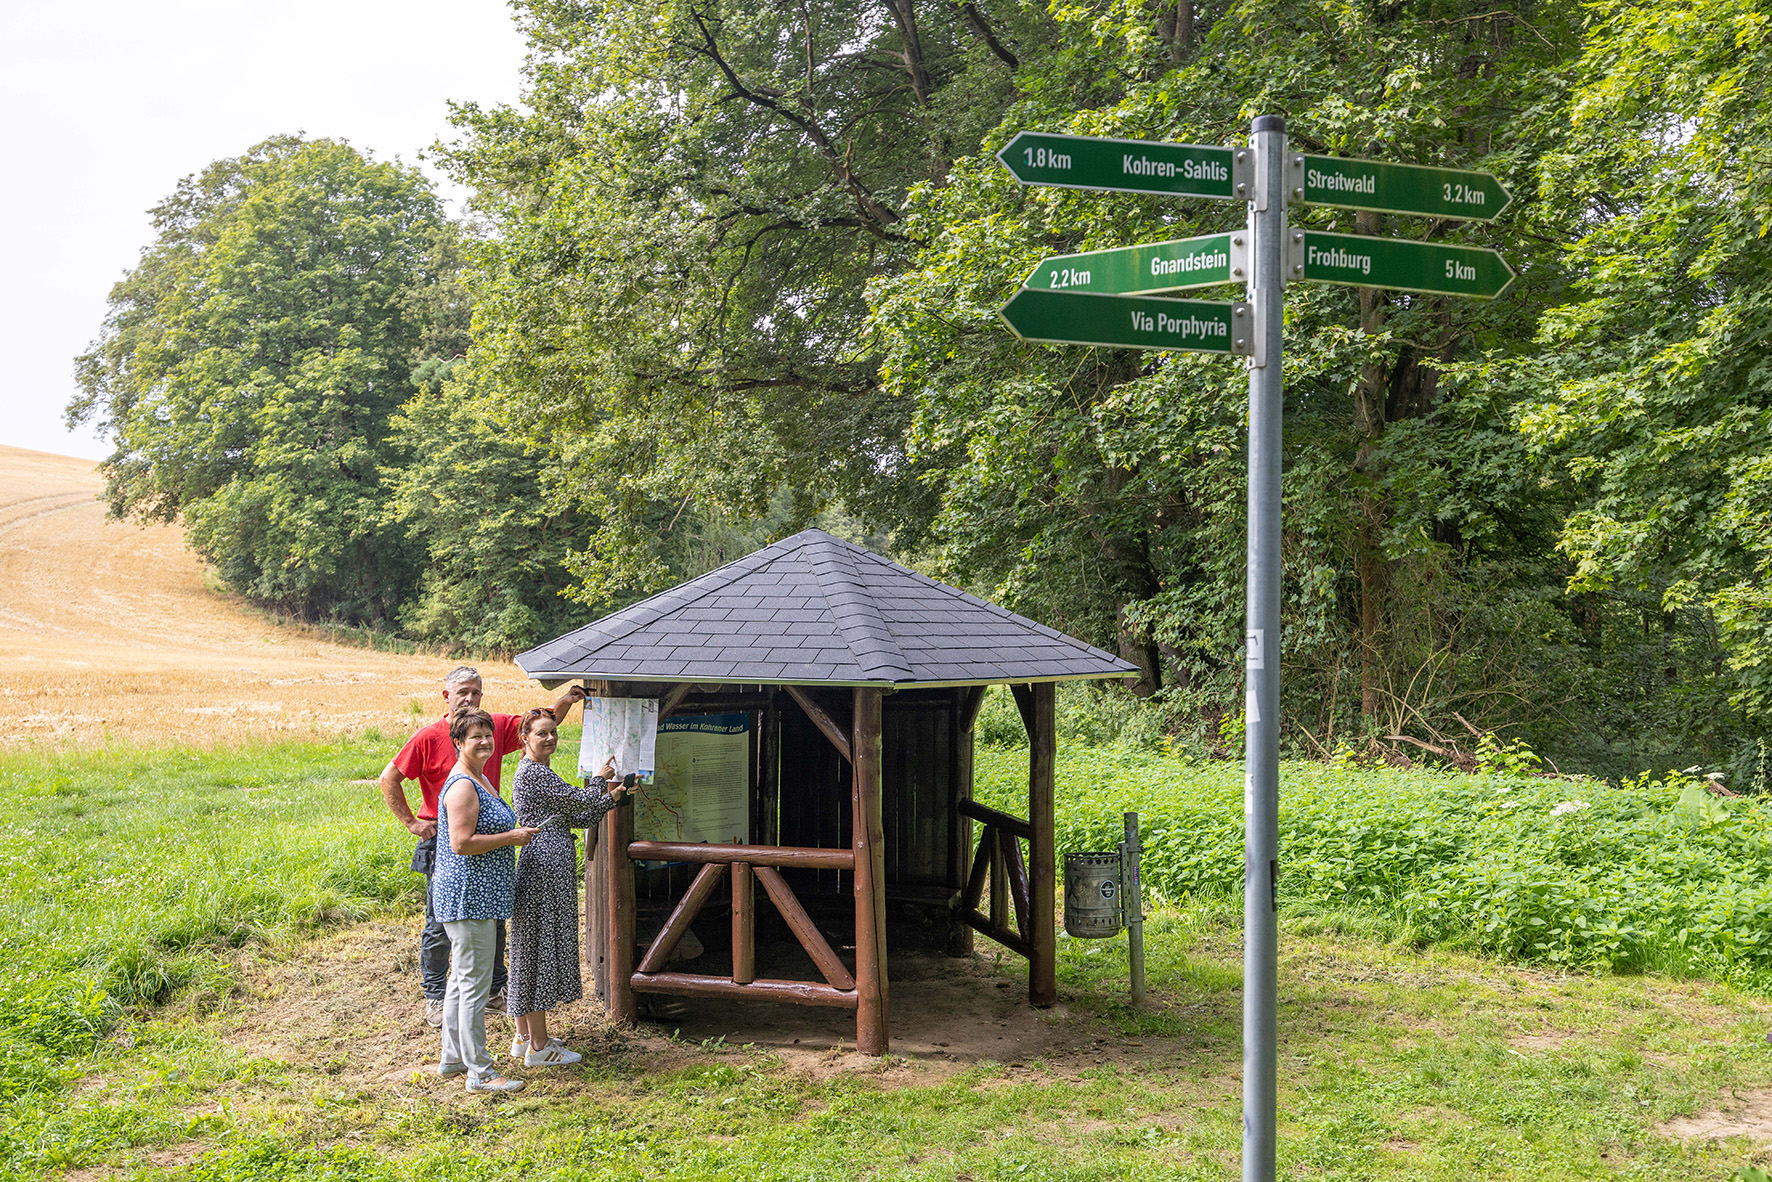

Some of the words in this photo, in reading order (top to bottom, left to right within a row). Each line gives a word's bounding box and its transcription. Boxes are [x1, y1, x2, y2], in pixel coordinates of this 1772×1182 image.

[1023, 146, 1046, 169] 1,8
[1048, 148, 1072, 170] km
[1122, 154, 1228, 182] Kohren-Sahlis
[1307, 168, 1375, 194] Streitwald
[1443, 182, 1463, 203] 3,2
[1464, 185, 1485, 205] km
[1151, 249, 1227, 276] Gnandstein
[1308, 245, 1371, 275] Frohburg
[1445, 259, 1454, 278] 5
[1456, 260, 1476, 281] km
[1050, 269, 1069, 289] 2,2
[1070, 268, 1091, 286] km
[1131, 310, 1154, 332] Via
[1158, 312, 1227, 340] Porphyria
[665, 722, 689, 731] Wasser
[699, 723, 728, 732] Kohrener
[729, 724, 744, 733] Land
